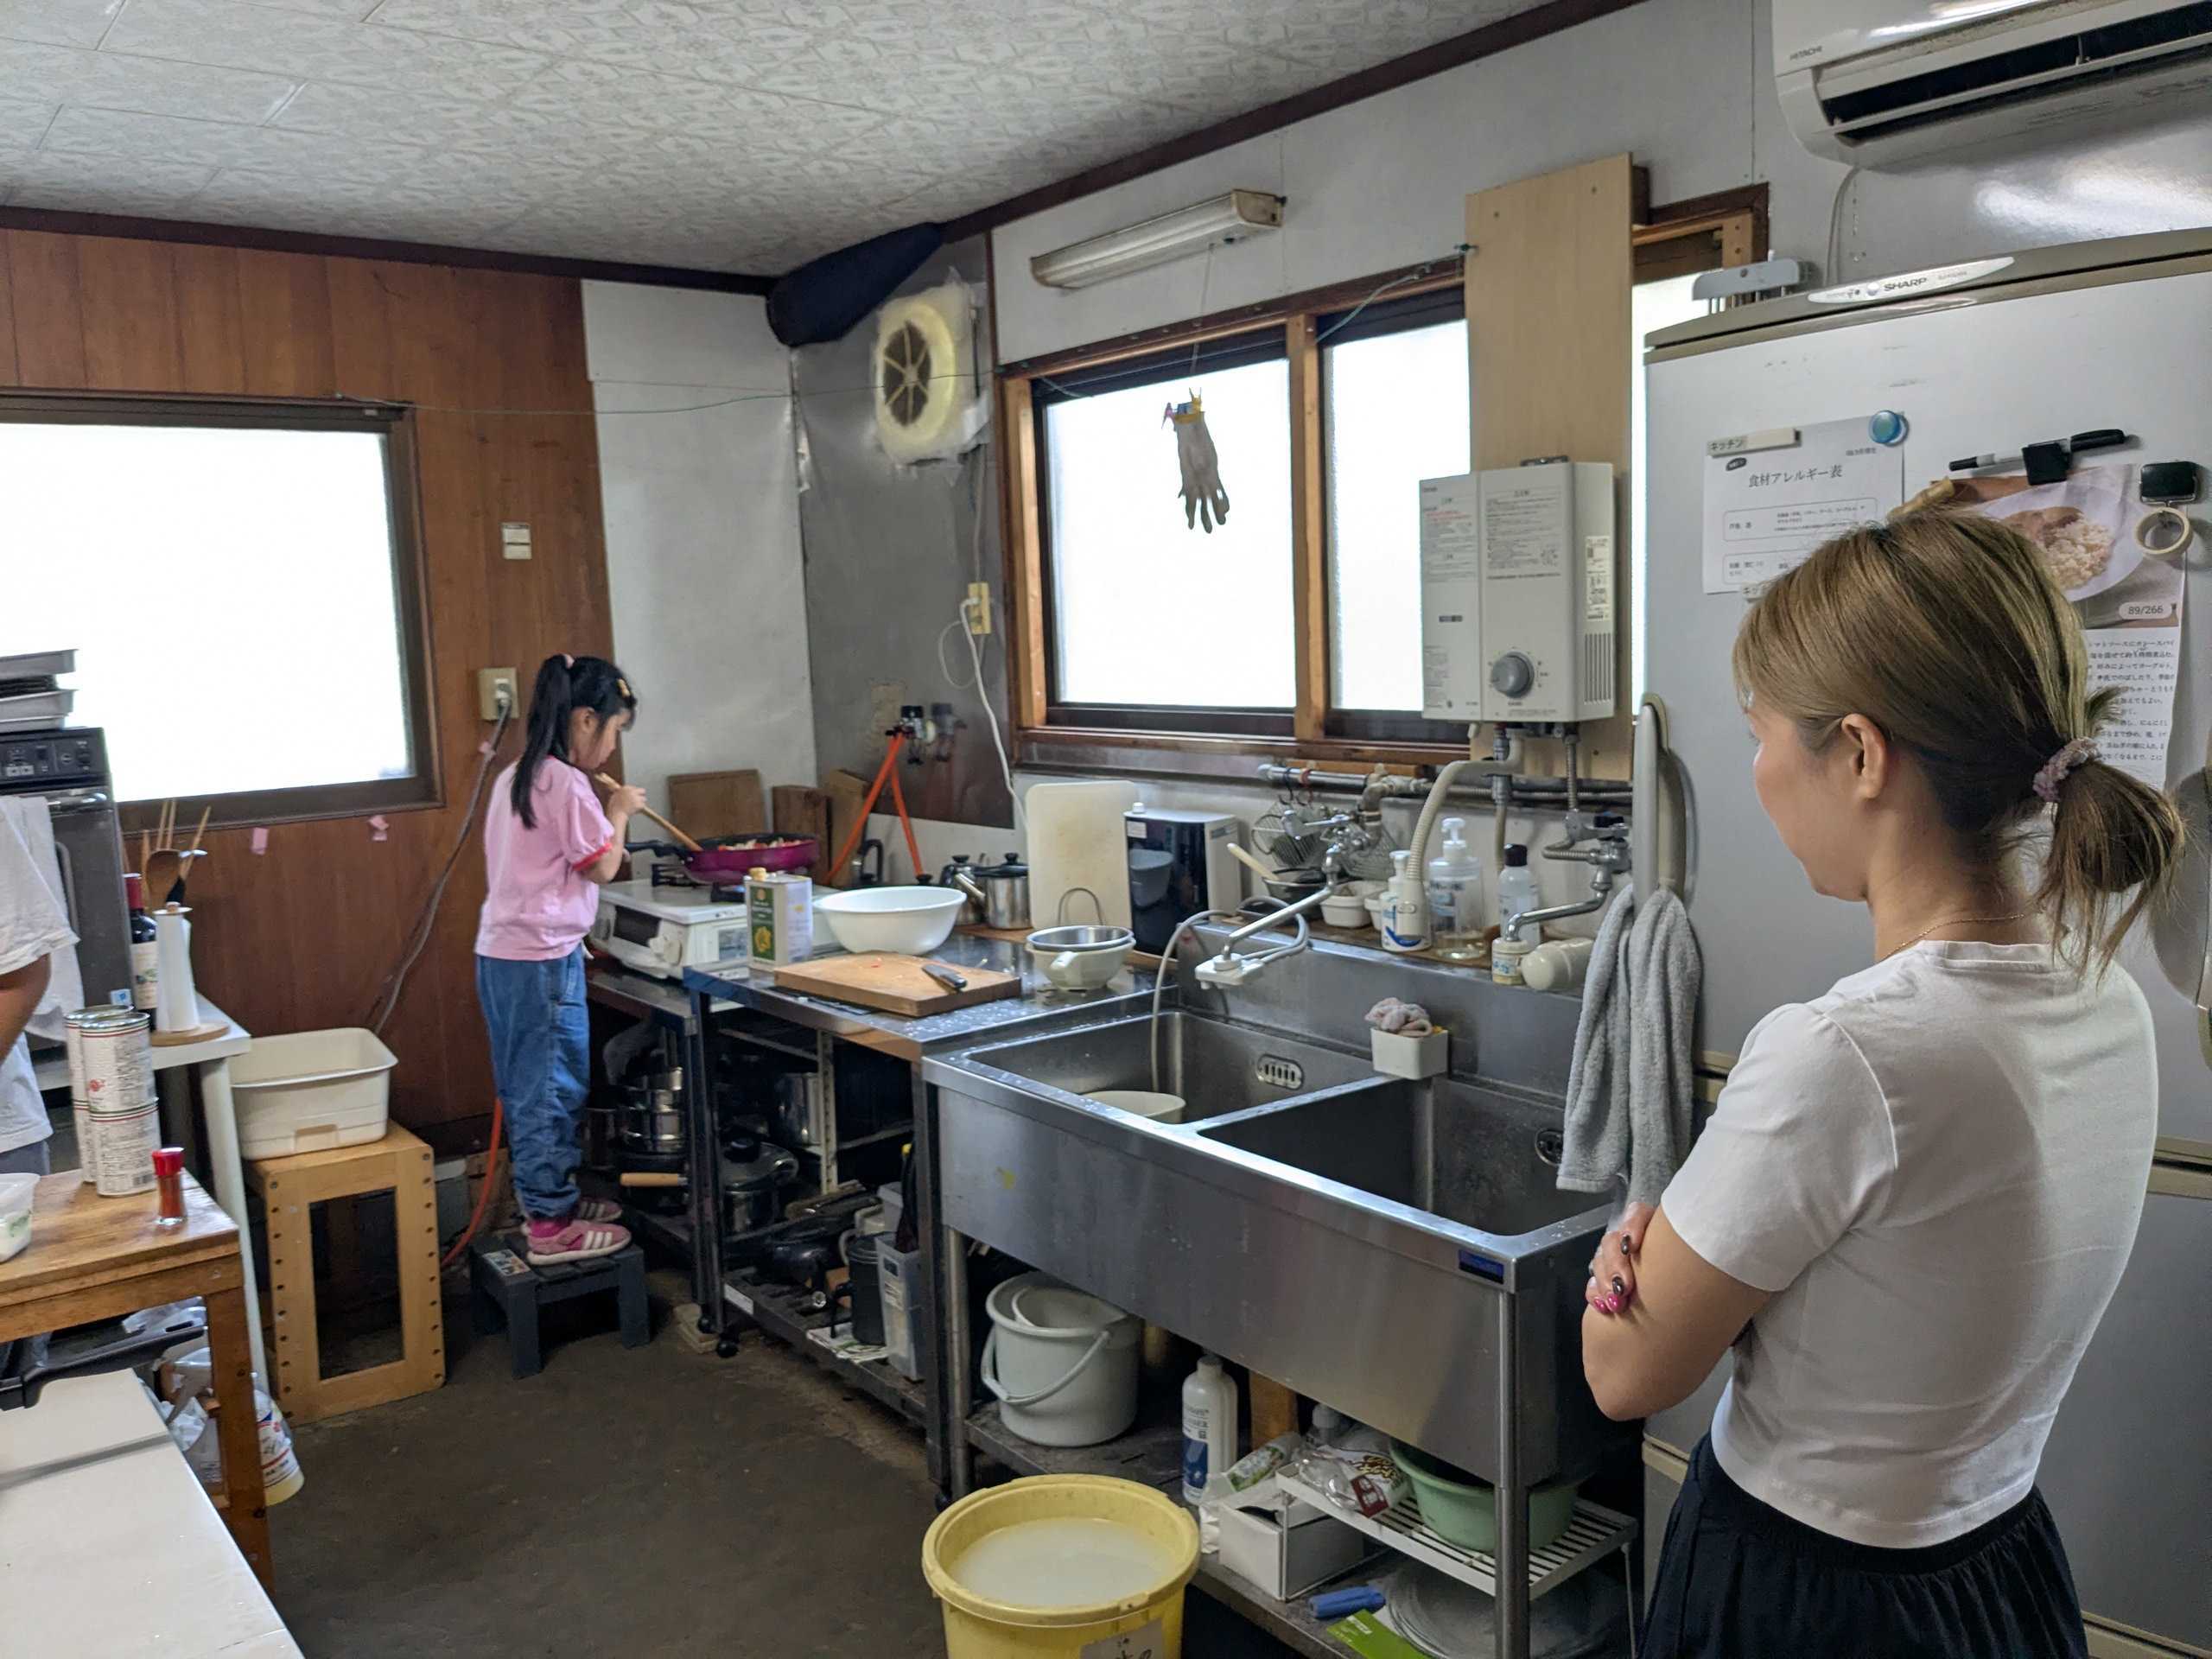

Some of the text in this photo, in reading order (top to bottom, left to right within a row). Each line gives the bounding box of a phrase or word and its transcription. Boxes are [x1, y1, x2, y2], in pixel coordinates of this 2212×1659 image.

[1884, 277, 1928, 292] SHARP
[1709, 438, 1745, 452] キッチン
[1748, 464, 1843, 488] 食材アレルギー表
[2127, 605, 2164, 616] 89/266
